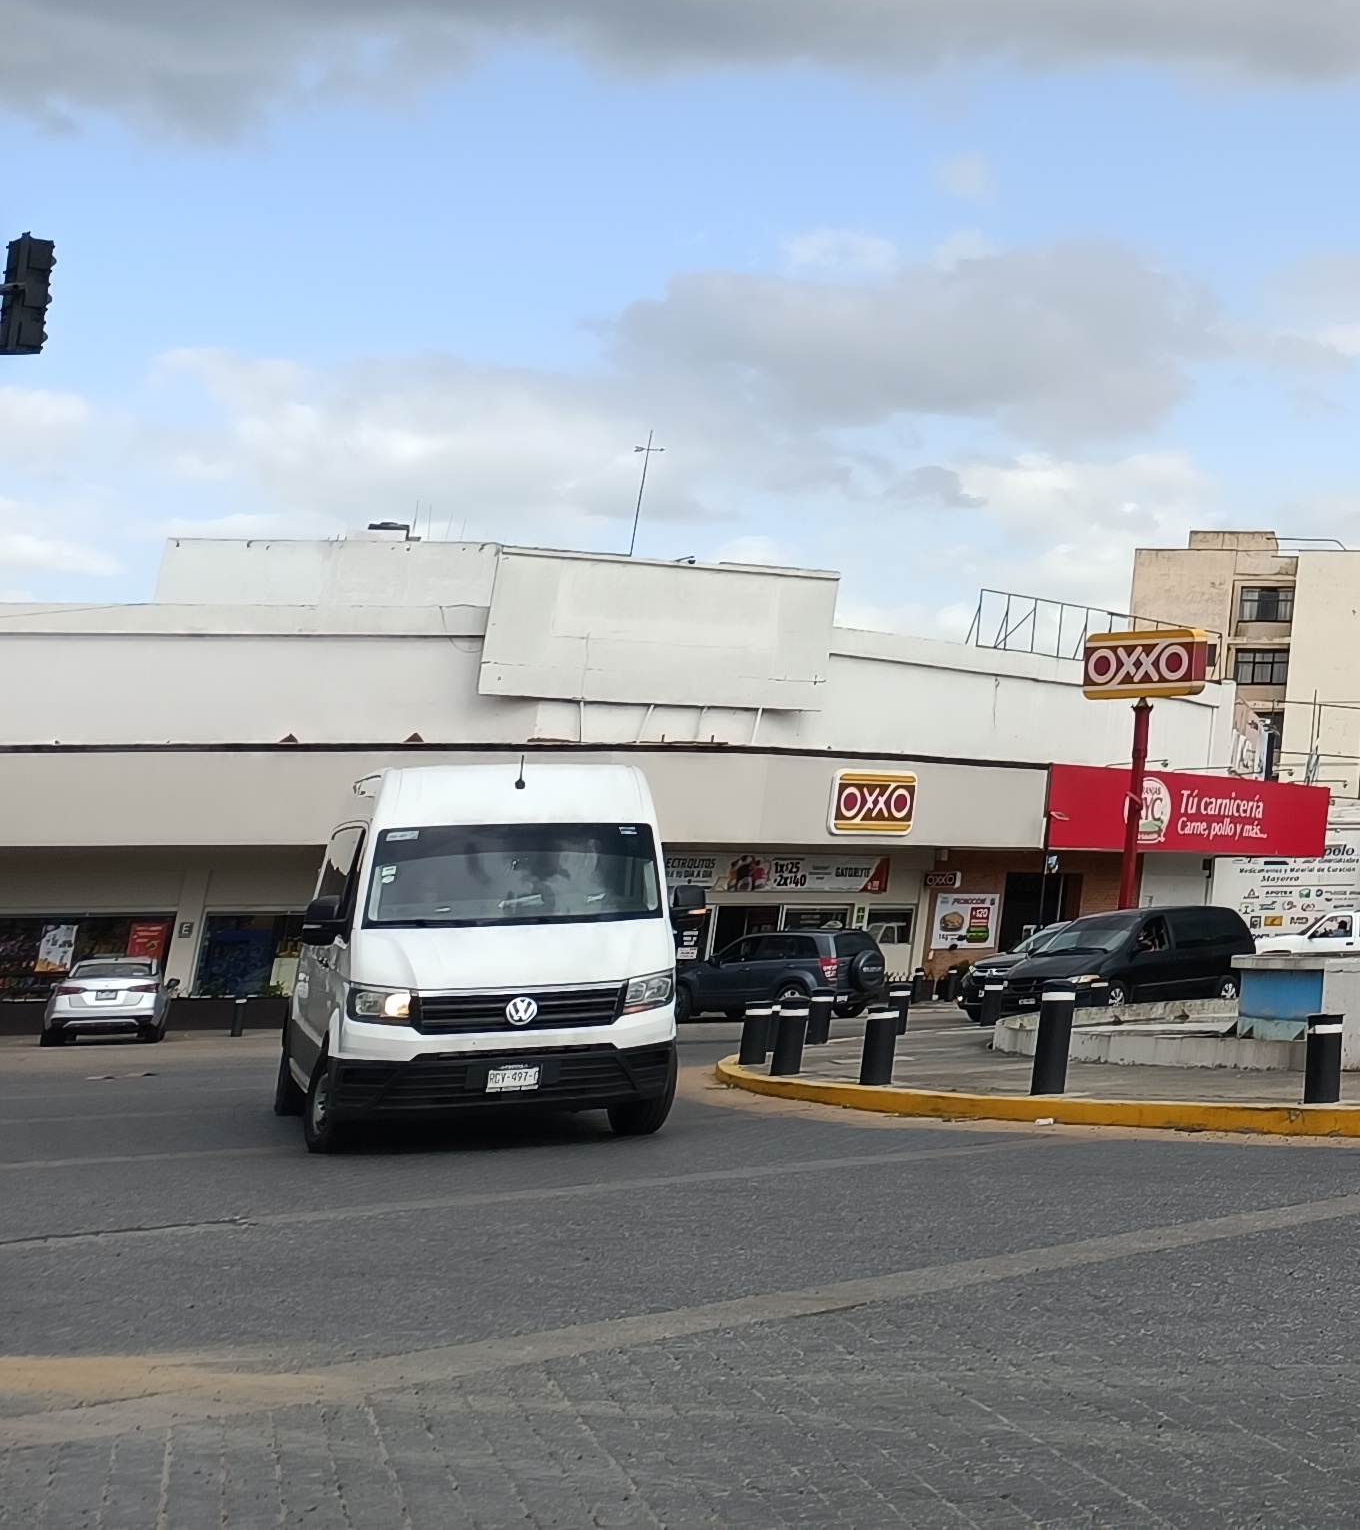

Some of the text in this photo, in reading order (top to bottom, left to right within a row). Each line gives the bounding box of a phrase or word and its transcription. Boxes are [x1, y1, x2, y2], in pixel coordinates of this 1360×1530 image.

[1088, 643, 1189, 685] OXXO
[840, 785, 910, 820] OXXO
[1180, 790, 1263, 818] Tú carnicería
[1177, 817, 1208, 838] Carne,
[1210, 818, 1235, 840] pollo
[1235, 823, 1242, 840] y
[926, 874, 955, 885] OXXO
[1261, 875, 1299, 883] Mayoreo
[181, 924, 190, 934] E
